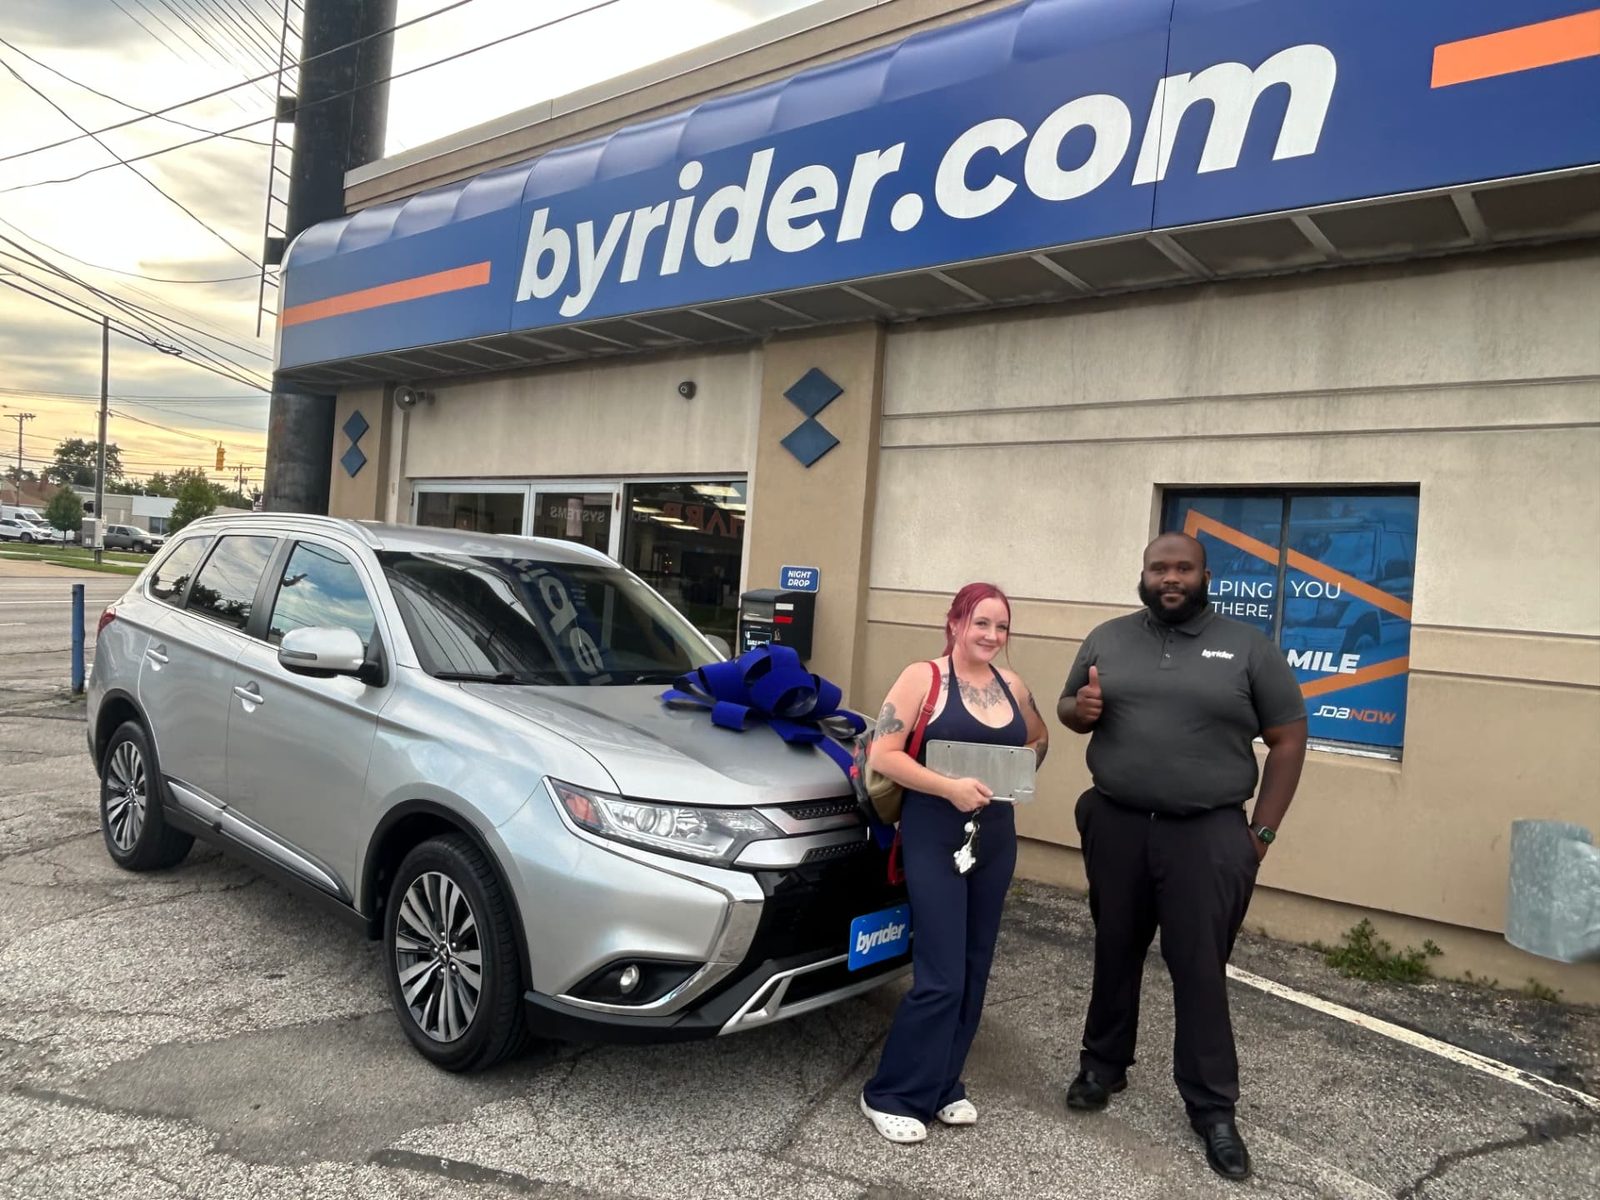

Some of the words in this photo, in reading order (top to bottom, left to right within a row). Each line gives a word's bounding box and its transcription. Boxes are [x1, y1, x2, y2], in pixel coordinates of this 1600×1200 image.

[514, 43, 1338, 318] byrider.com
[787, 570, 812, 579] NIGHT
[787, 578, 811, 587] DROP
[1207, 579, 1273, 599] LPING
[1290, 580, 1341, 599] YOU
[1210, 601, 1273, 621] THERE,
[1286, 648, 1361, 674] MILE
[856, 922, 906, 955] byrider
